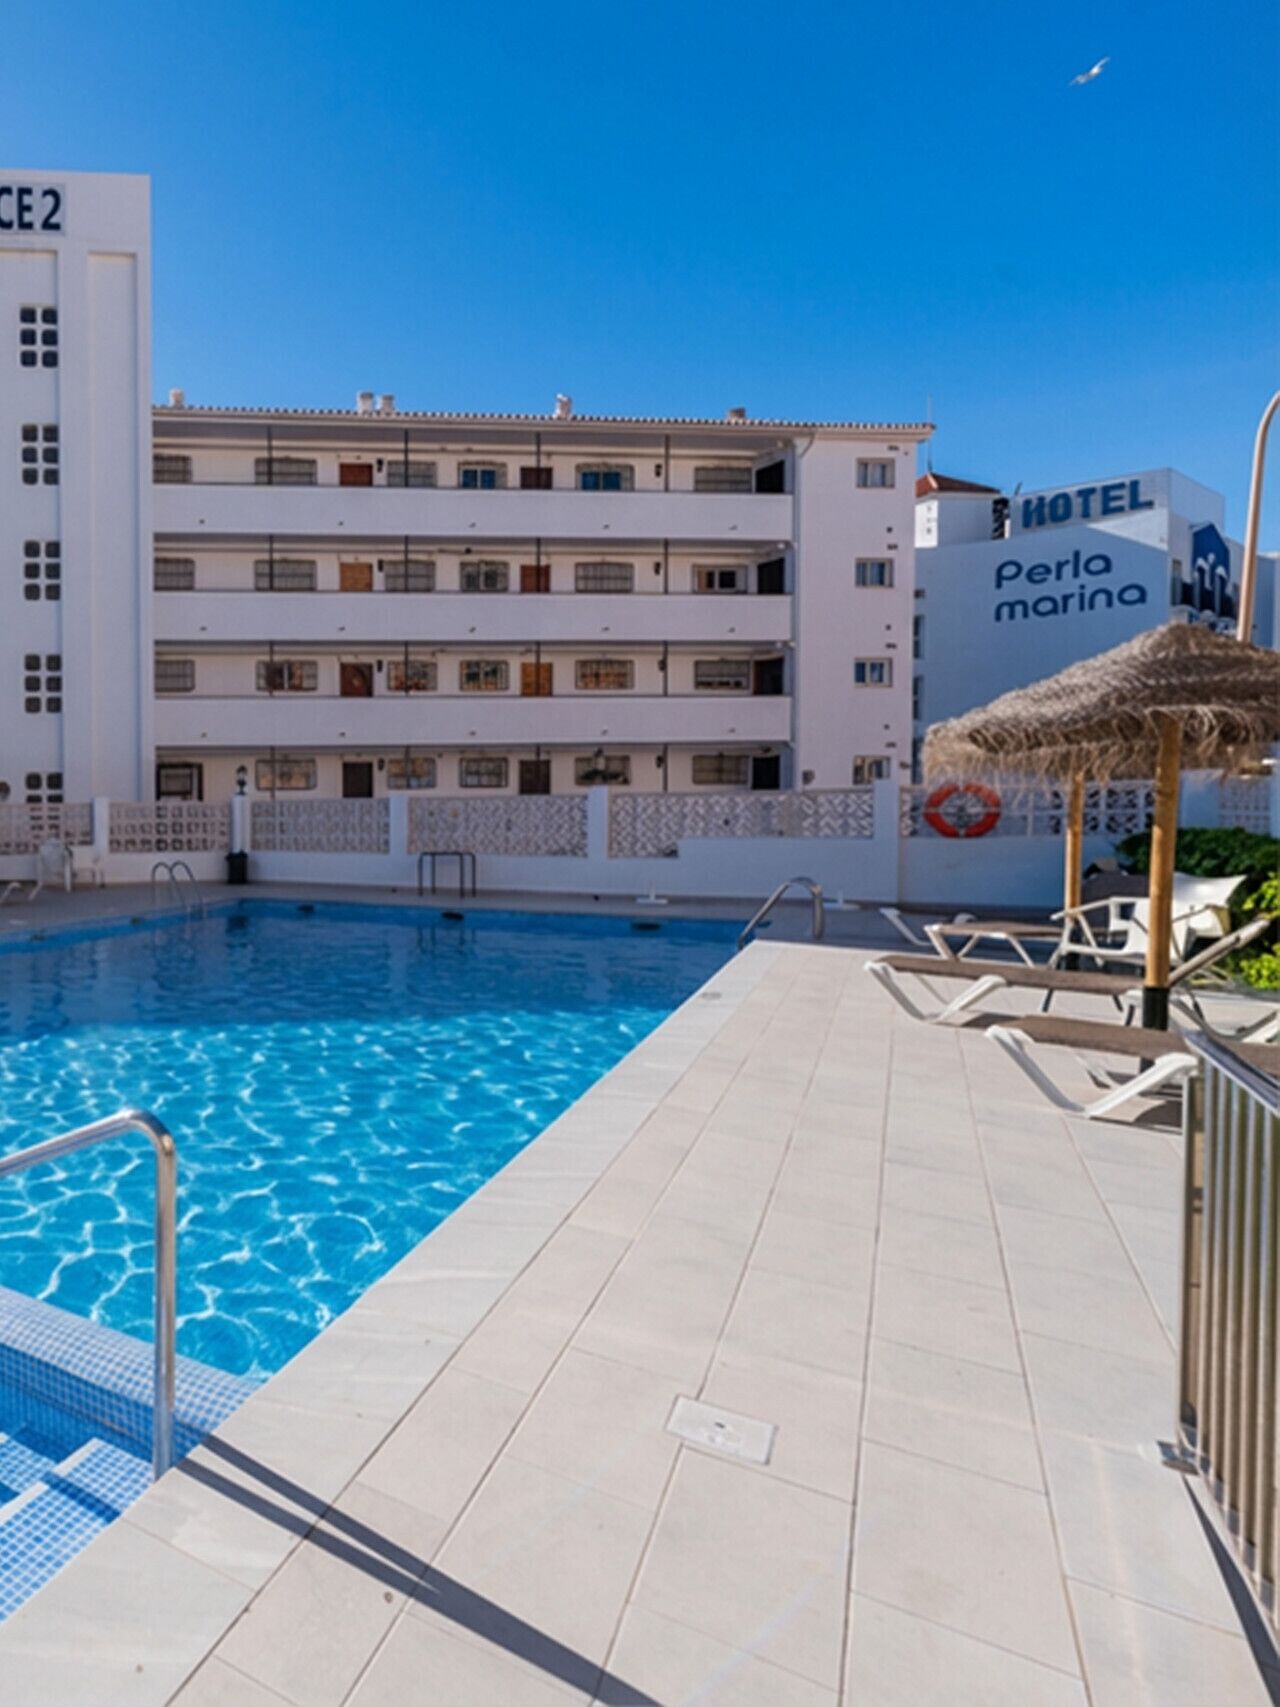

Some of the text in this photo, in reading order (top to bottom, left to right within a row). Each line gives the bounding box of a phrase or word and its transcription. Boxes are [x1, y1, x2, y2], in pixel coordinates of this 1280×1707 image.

[41, 188, 62, 230] 2
[1022, 479, 1154, 528] HOTEL
[995, 584, 1148, 622] marina
